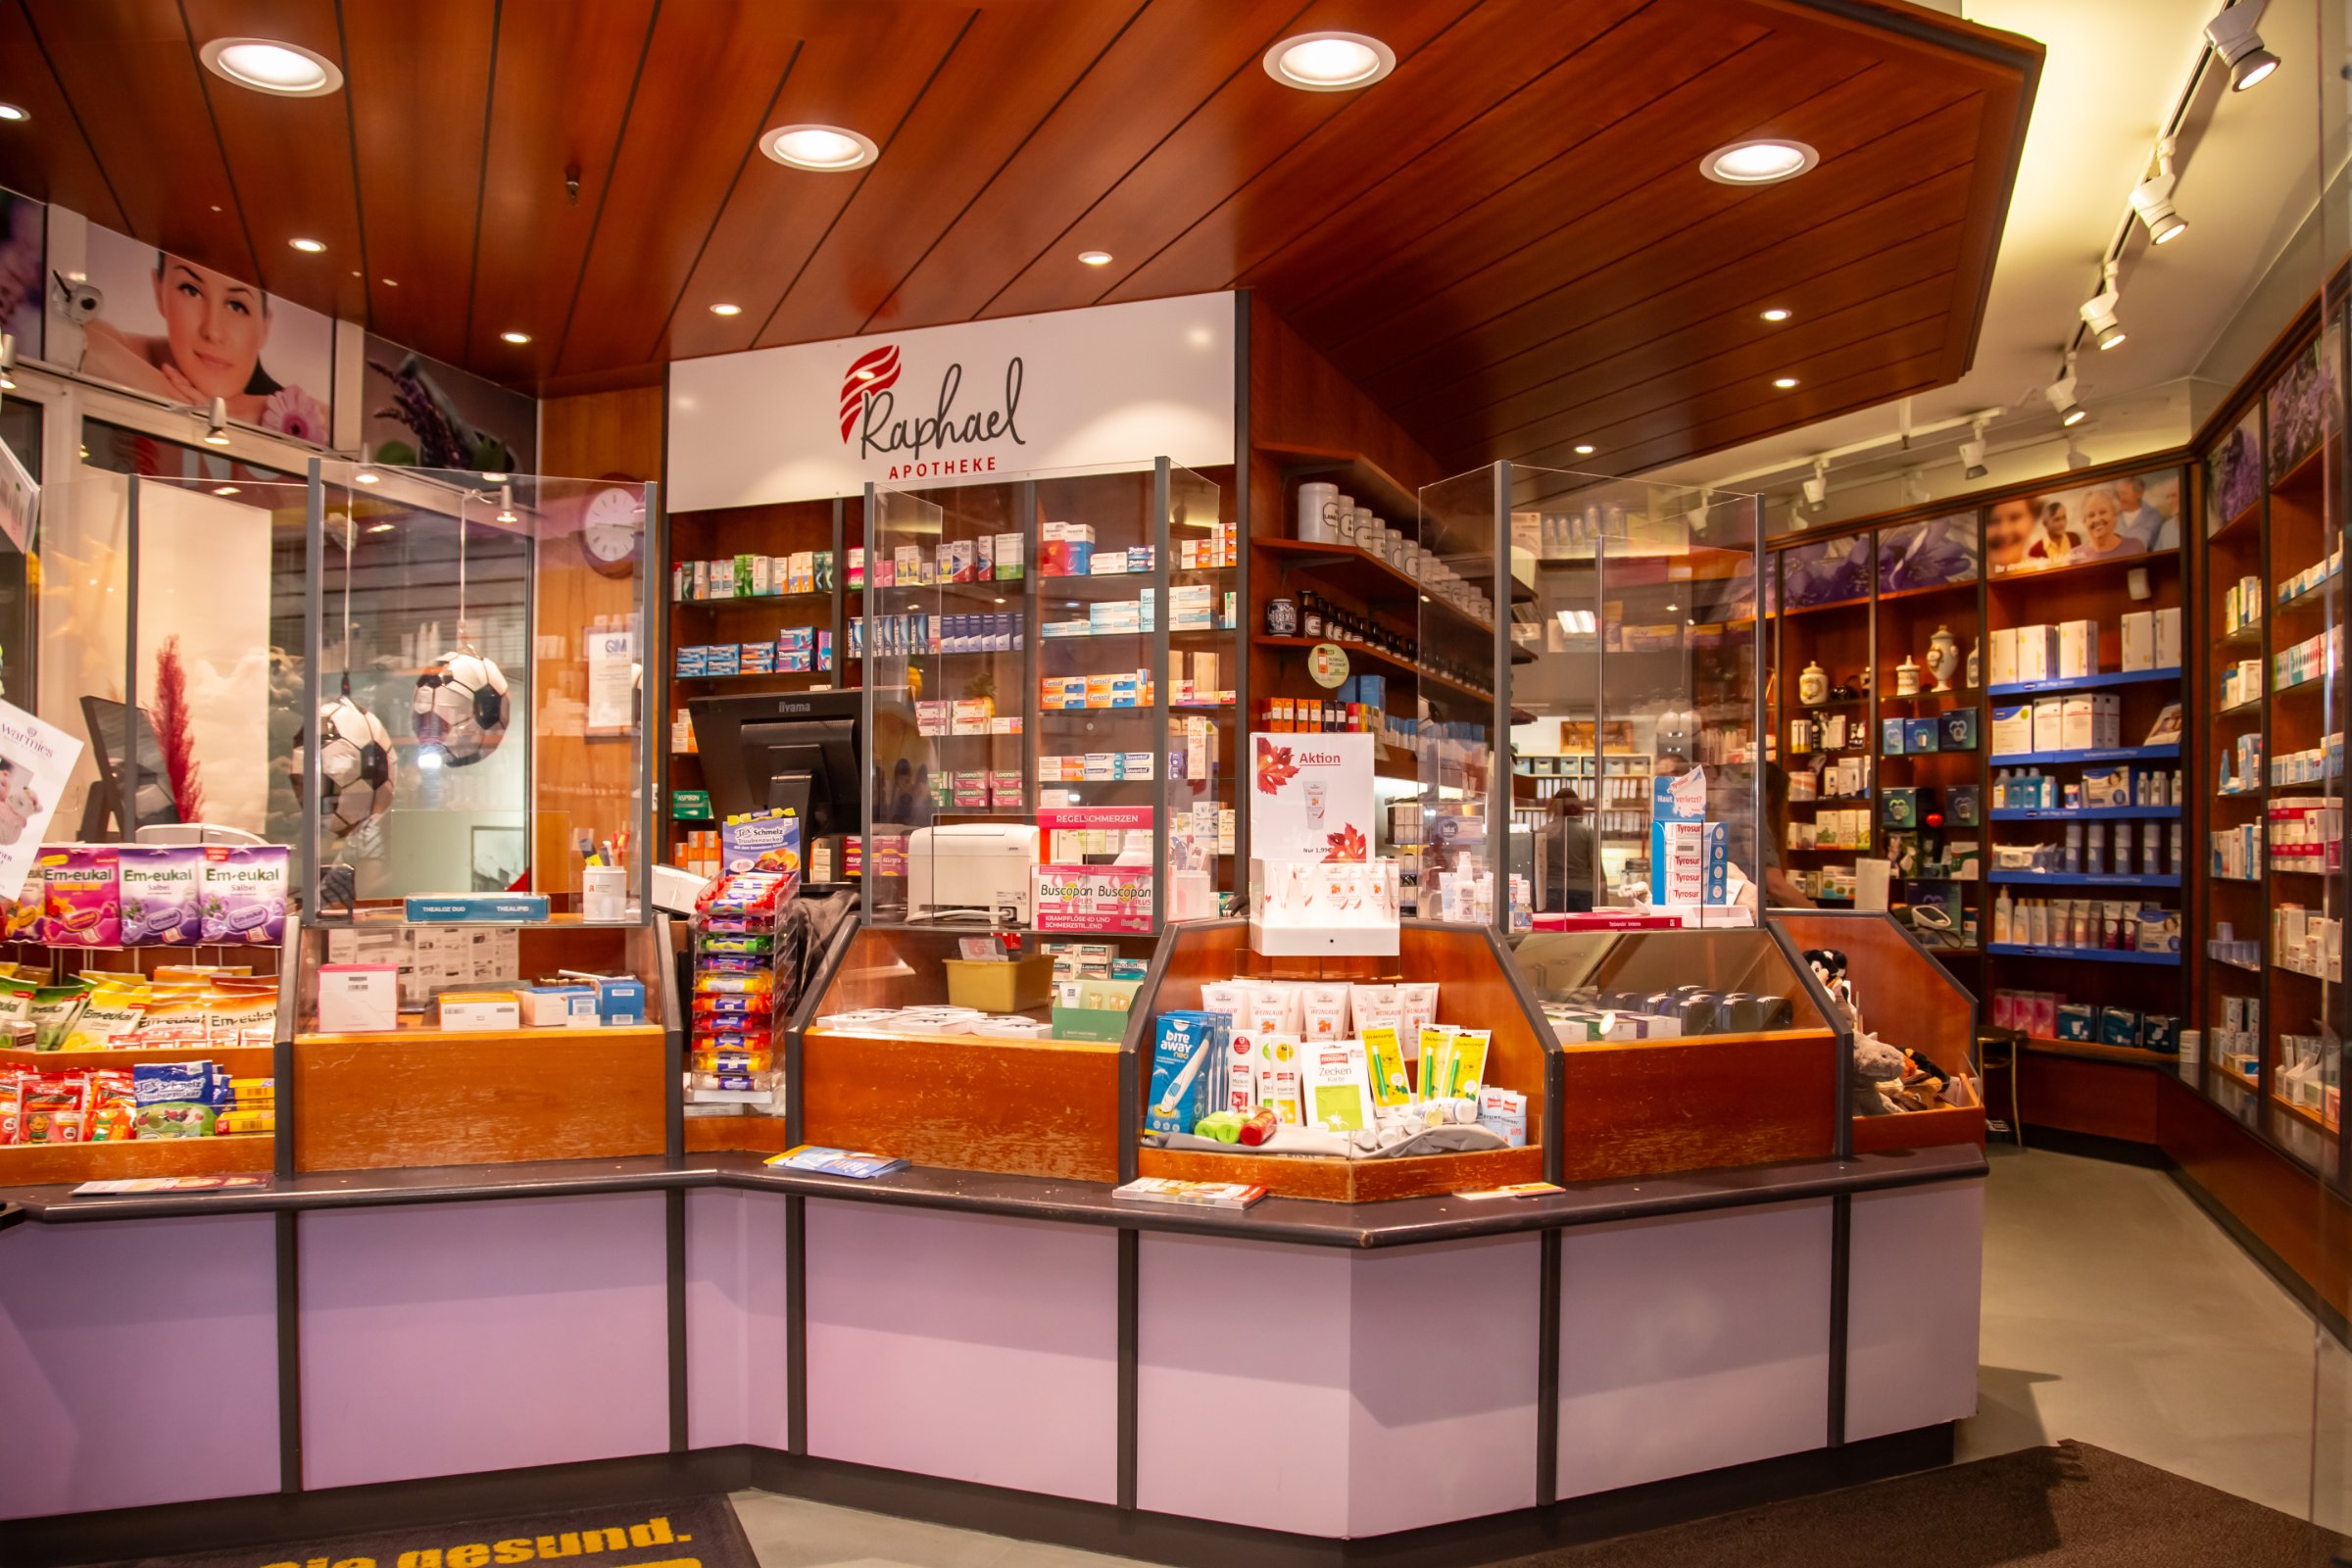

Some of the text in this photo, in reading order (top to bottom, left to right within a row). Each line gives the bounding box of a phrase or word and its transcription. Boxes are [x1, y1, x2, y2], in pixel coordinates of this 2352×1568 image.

[860, 357, 1026, 460] Raphael
[889, 457, 997, 480] APOTHEKE
[1299, 753, 1341, 763] Aktion
[1675, 795, 1702, 804] verletzt?
[1677, 824, 1701, 833] Tyrosur
[1676, 856, 1700, 865] Tyrosur
[44, 868, 112, 881] Em-eukal
[123, 869, 192, 882] Em-eukal
[206, 868, 279, 882] Em-eukal
[1676, 873, 1700, 882] Tyrosur
[1041, 885, 1093, 899] Buscopan
[1098, 885, 1152, 900] Buscopan
[1674, 890, 1699, 900] Tyrosur
[83, 1009, 136, 1021] Em-eukal
[1160, 1042, 1193, 1054] away
[1319, 1066, 1351, 1076] Zecken
[396, 1517, 692, 1568] gesund.
